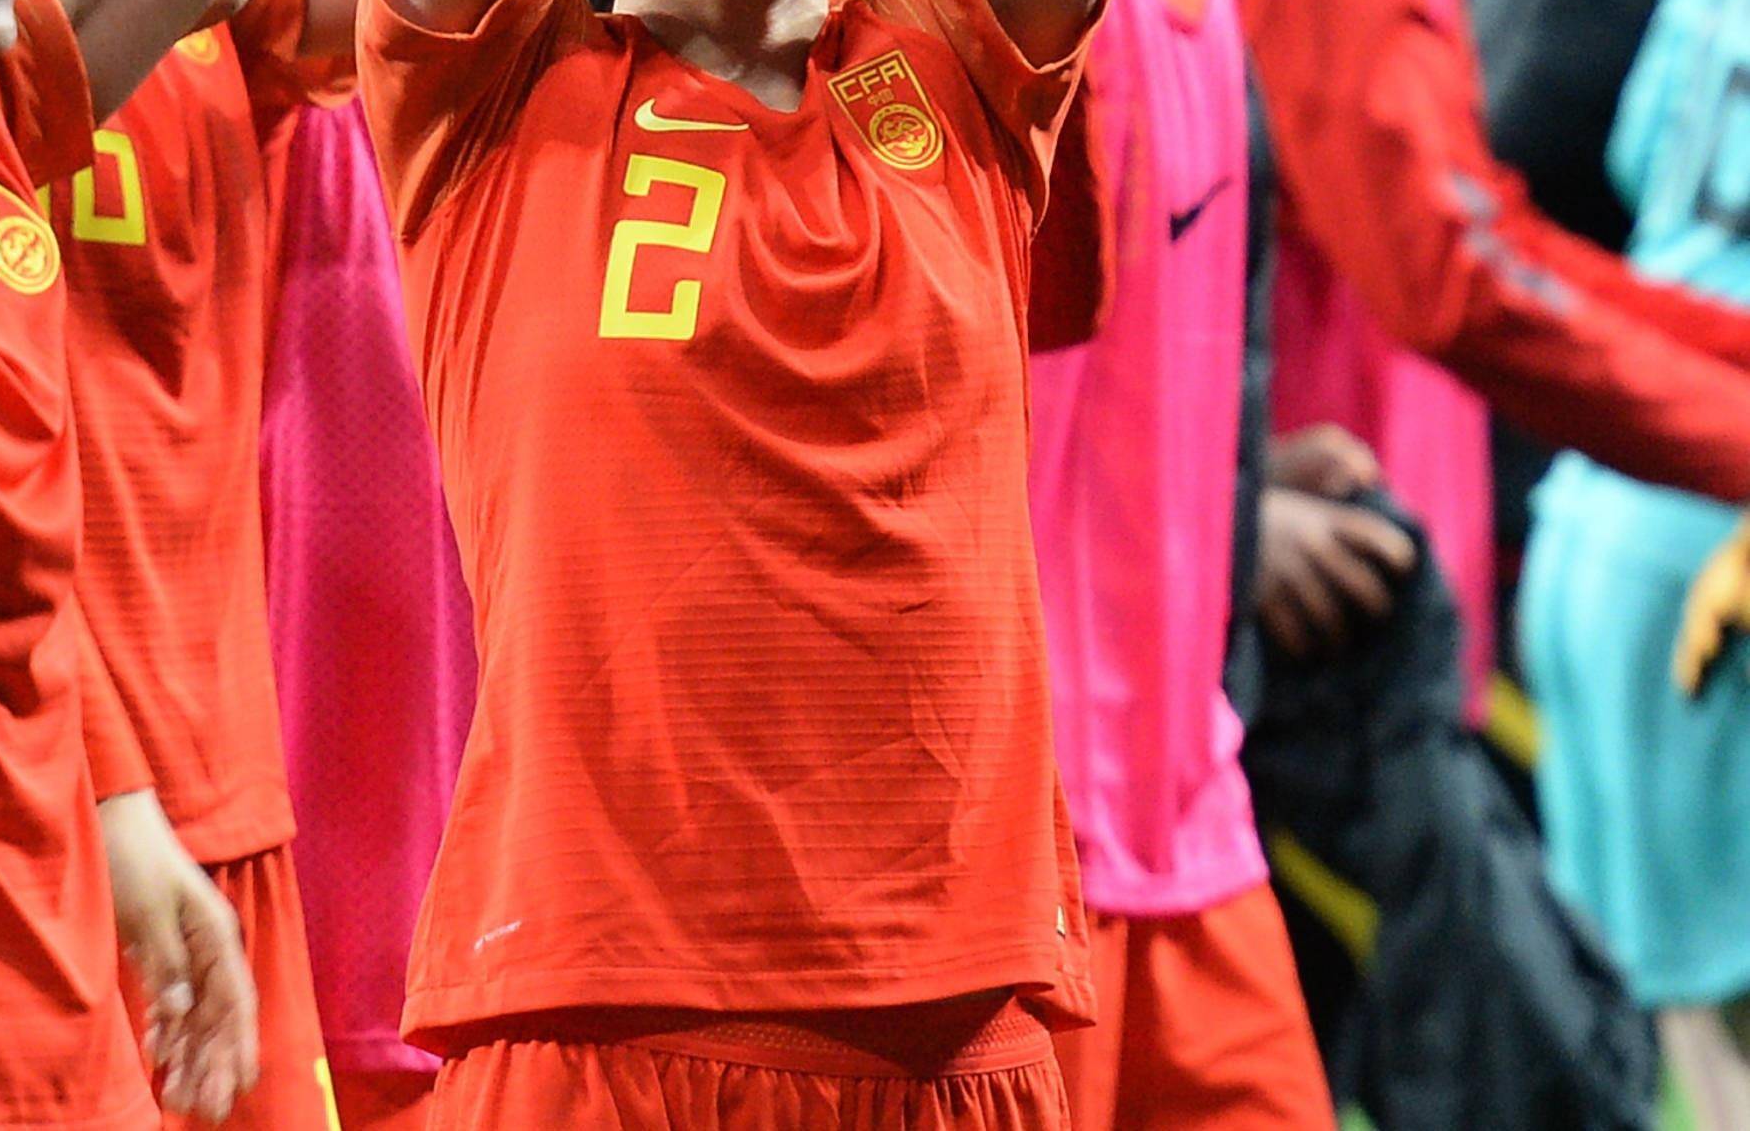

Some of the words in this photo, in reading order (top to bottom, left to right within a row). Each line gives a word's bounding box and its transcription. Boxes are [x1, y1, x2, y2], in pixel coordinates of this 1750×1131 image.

[836, 59, 906, 103] CFA
[36, 128, 147, 246] 0
[598, 154, 726, 341] 2
